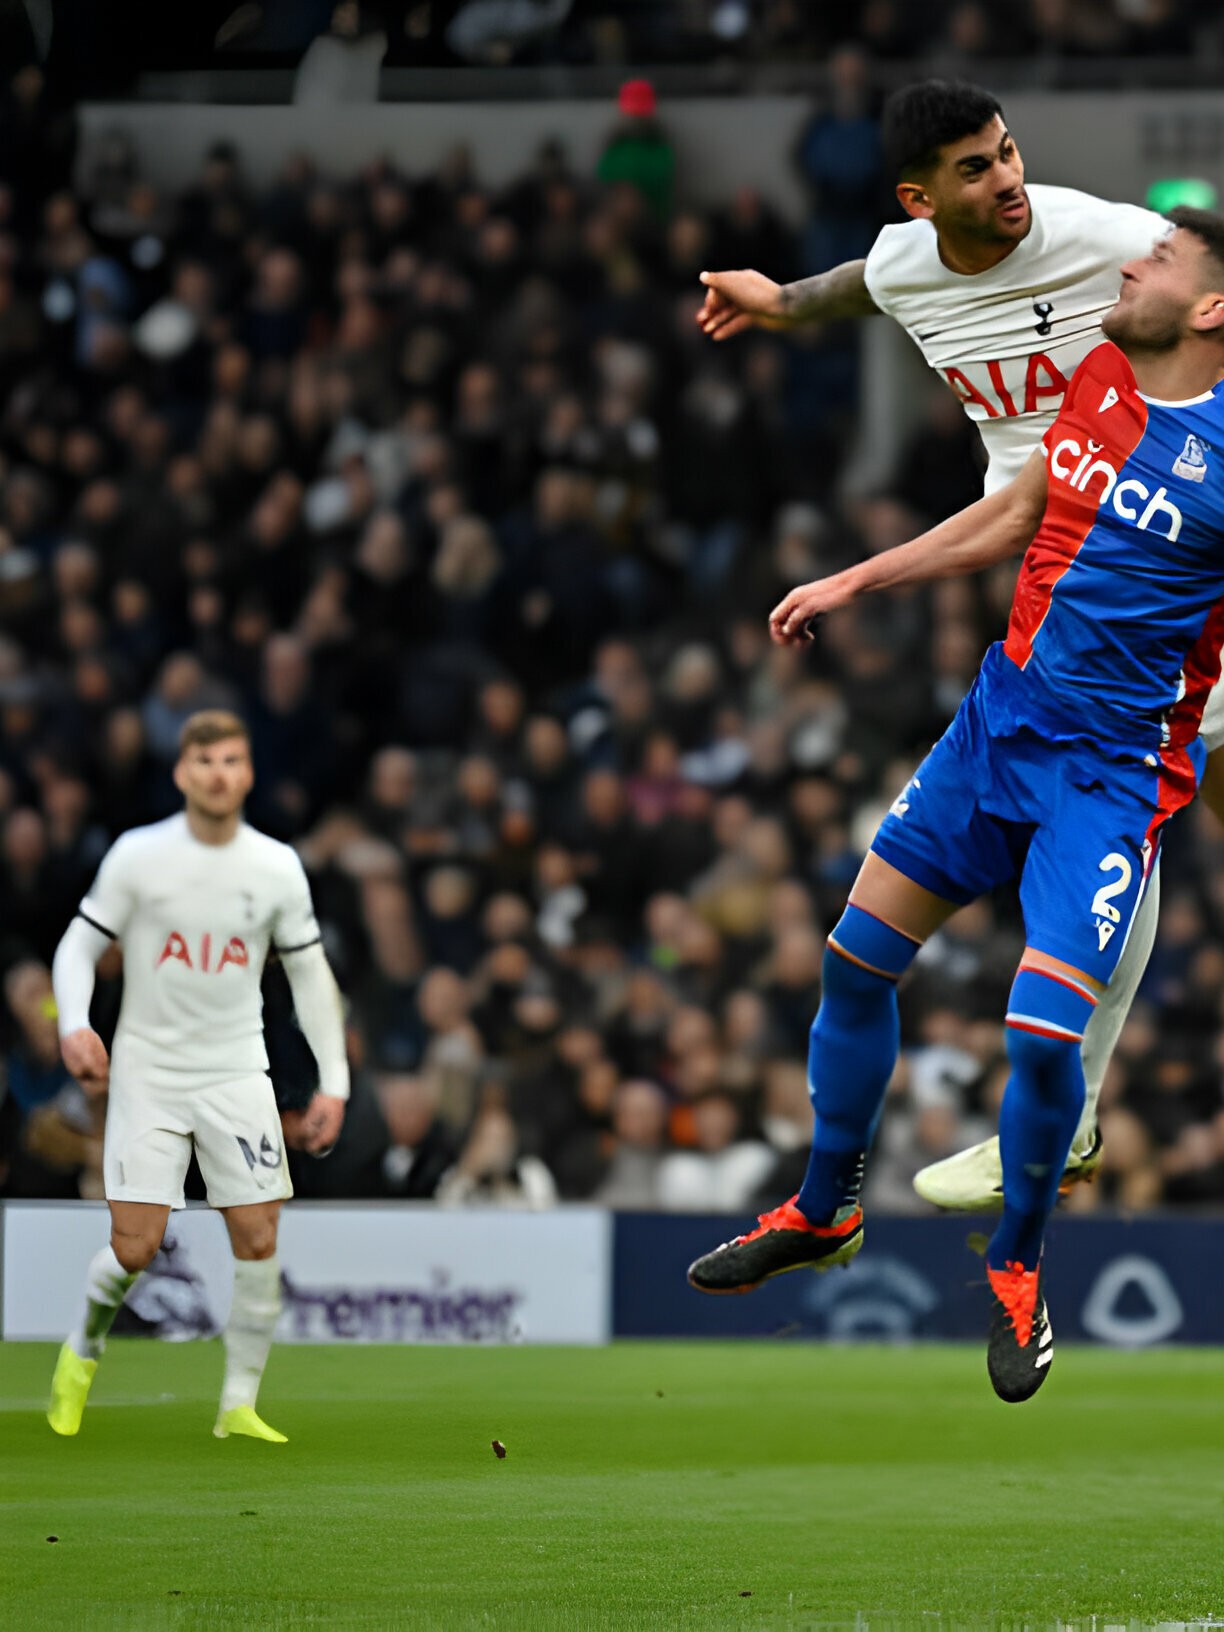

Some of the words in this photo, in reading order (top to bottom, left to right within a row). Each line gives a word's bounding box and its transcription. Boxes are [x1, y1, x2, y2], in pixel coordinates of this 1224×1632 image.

[1051, 438, 1182, 542] cinch
[1091, 852, 1132, 923] 2
[154, 930, 249, 974] AIA
[279, 1266, 523, 1340] remier
